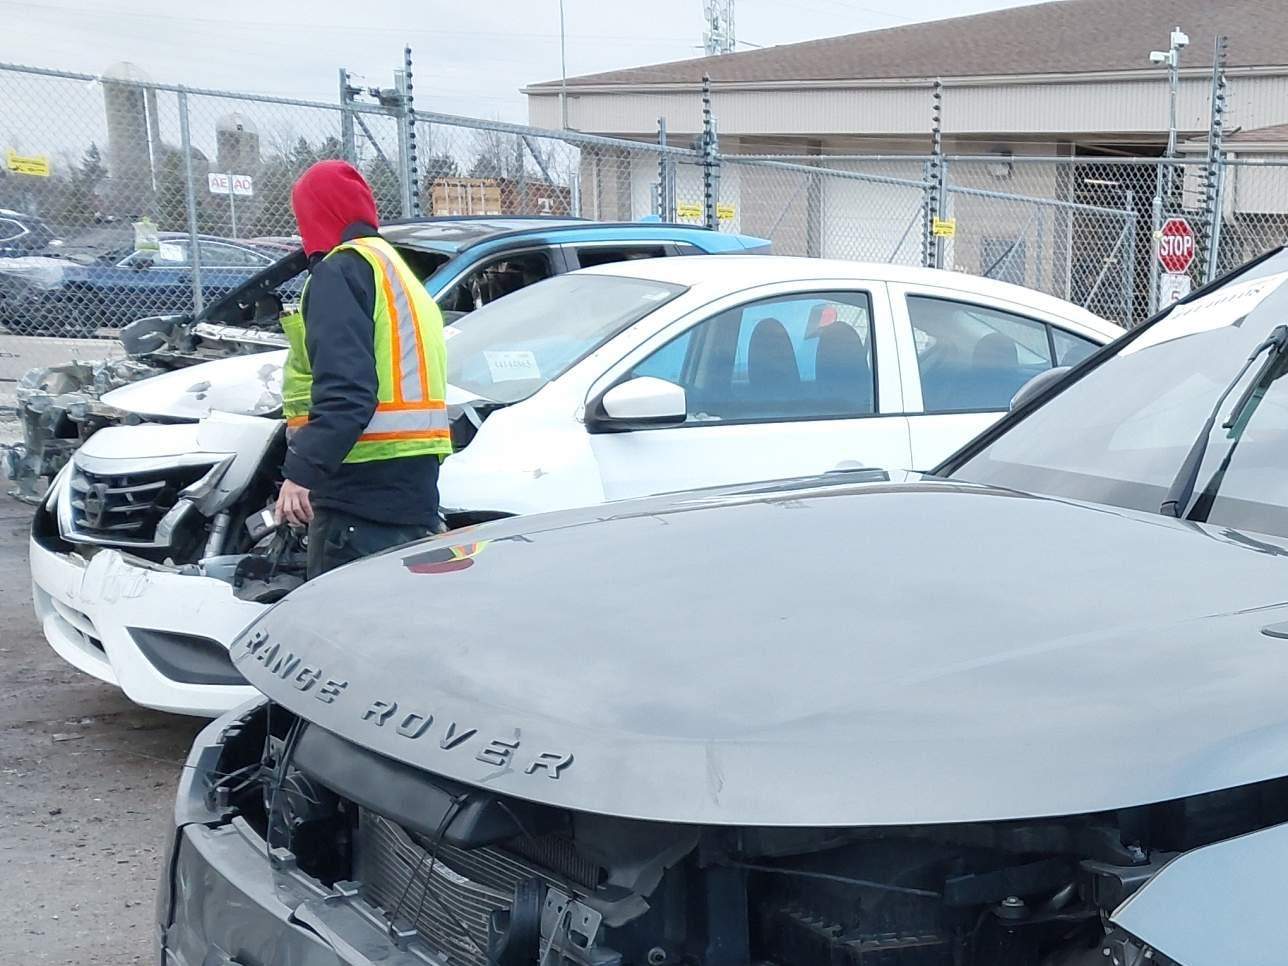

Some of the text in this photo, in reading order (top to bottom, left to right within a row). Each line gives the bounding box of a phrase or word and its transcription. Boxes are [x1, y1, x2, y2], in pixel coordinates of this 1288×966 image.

[1160, 235, 1192, 257] STOP
[245, 629, 575, 780] RANGE ROVER
